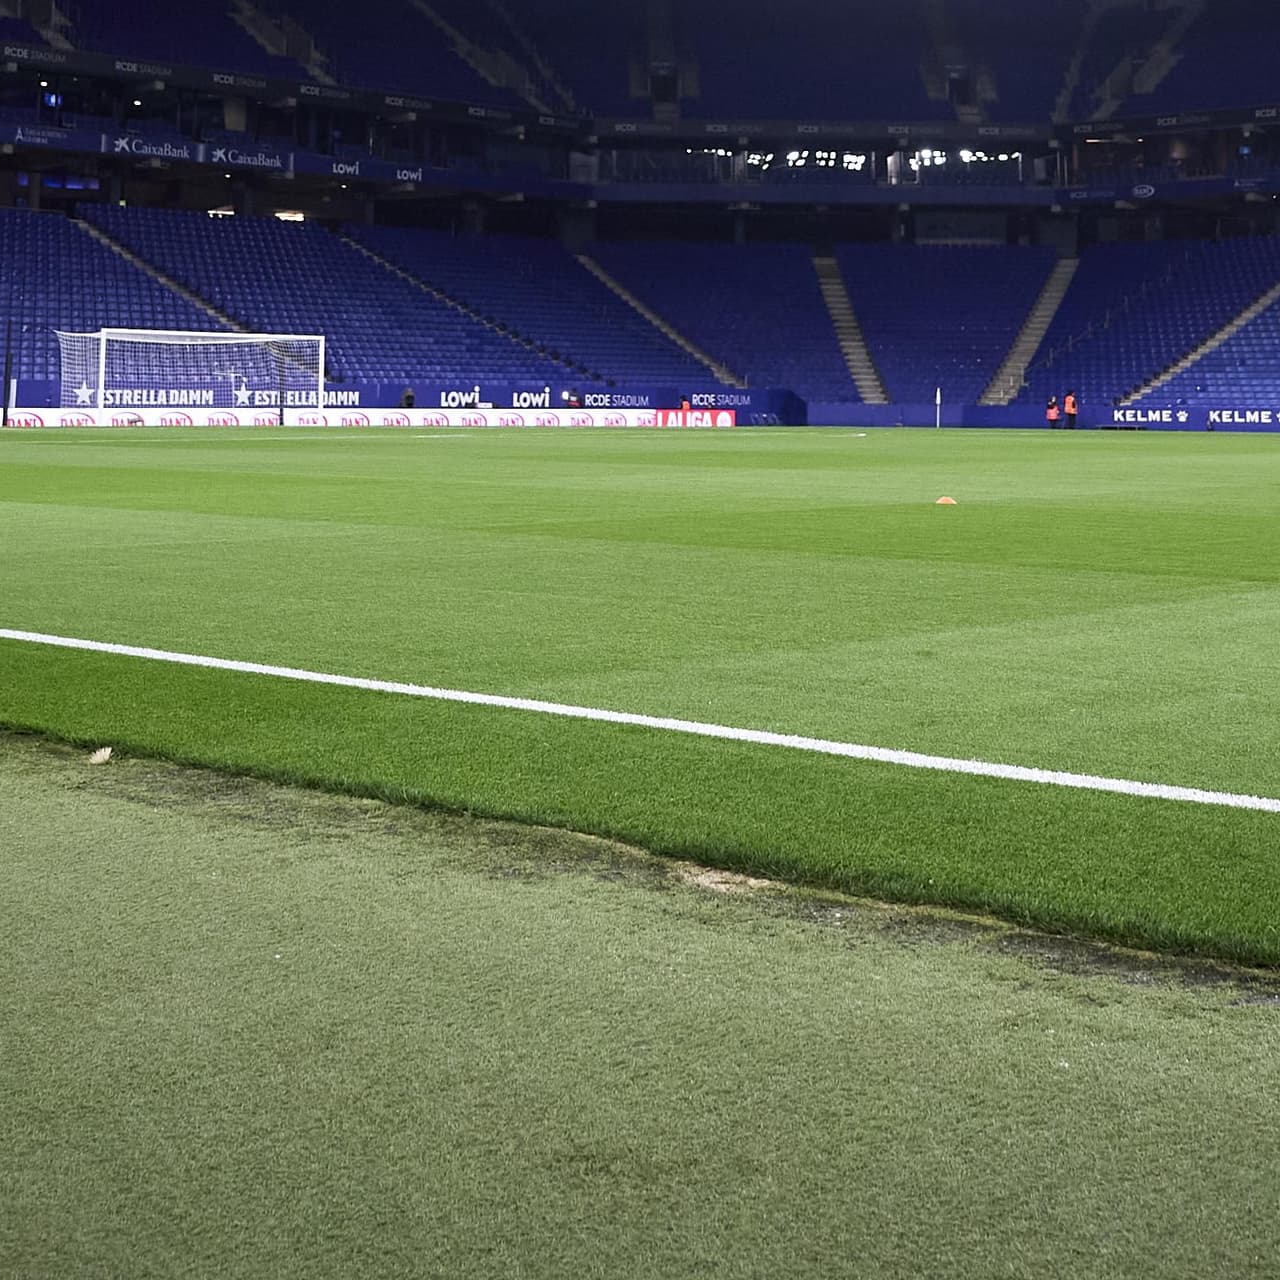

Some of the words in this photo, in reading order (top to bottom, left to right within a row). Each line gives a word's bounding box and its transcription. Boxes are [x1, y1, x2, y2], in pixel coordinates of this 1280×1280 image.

[4, 46, 29, 58] RCDE
[131, 139, 191, 160] CaixaBank
[227, 149, 283, 169] CaixaBank
[170, 389, 214, 405] DAMM
[254, 390, 317, 406] ESTELLA
[585, 394, 611, 406] RCDE
[612, 394, 649, 407] STADIUM
[692, 393, 716, 406] RCDE
[717, 394, 752, 406] STADIUM
[7, 418, 37, 427] DANI
[656, 411, 713, 427] LALIGA
[1113, 409, 1172, 422] KELME
[1209, 410, 1272, 424] KELME
